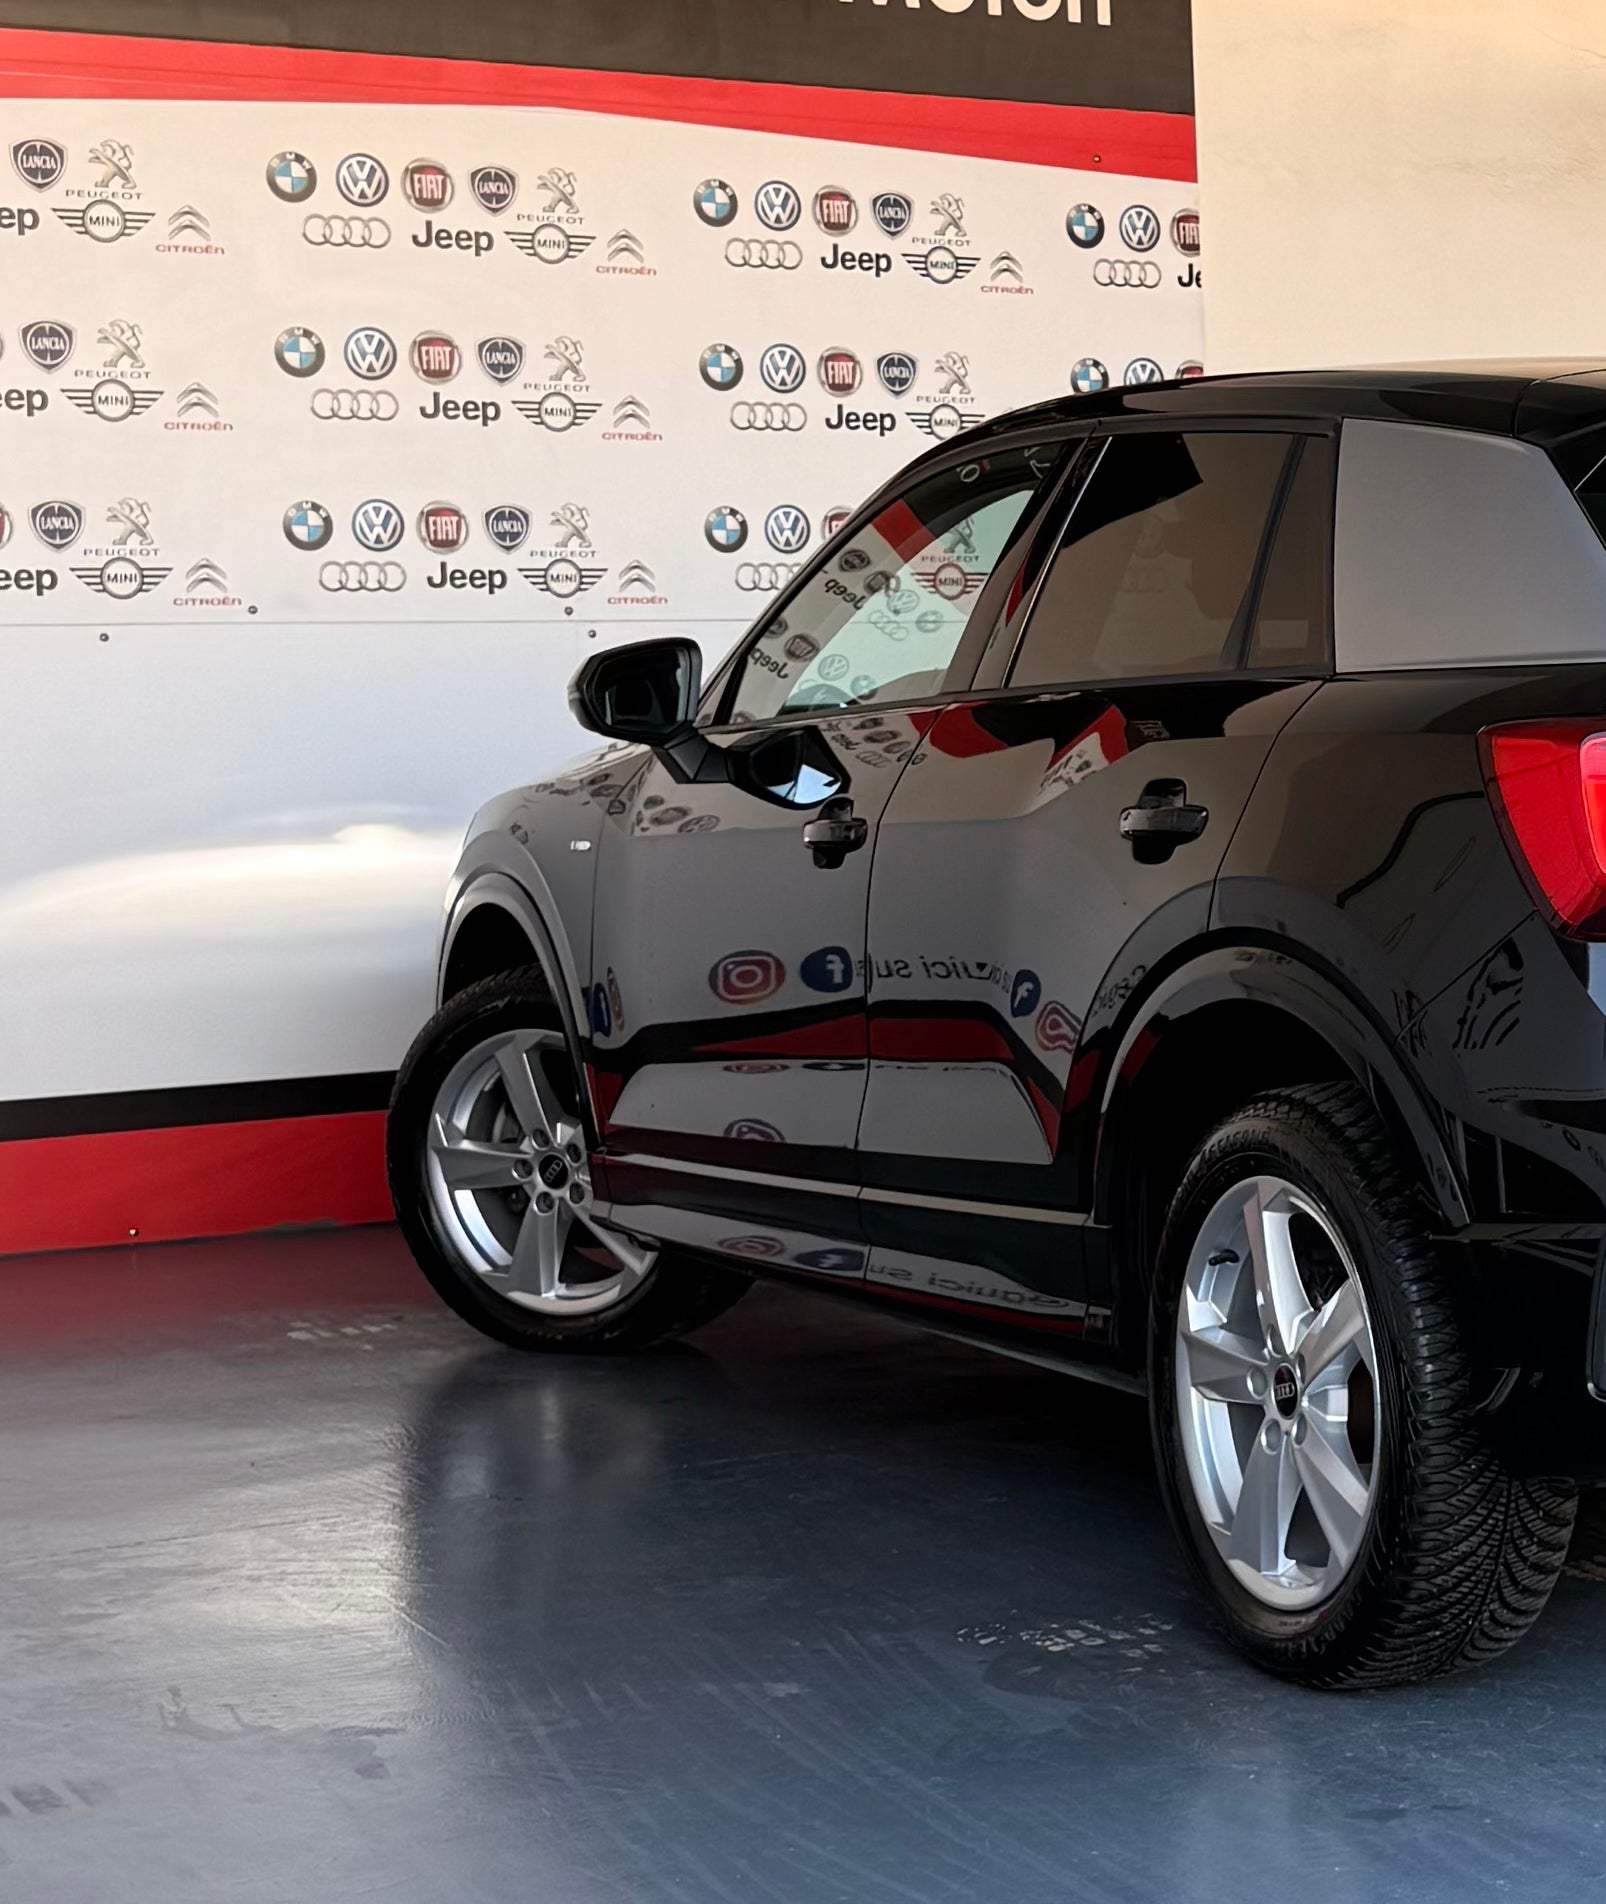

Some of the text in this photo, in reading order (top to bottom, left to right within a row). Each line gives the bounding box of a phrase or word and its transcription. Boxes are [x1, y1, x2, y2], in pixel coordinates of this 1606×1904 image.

[23, 154, 57, 170] LANCIA
[414, 173, 445, 200] FIAT
[65, 189, 143, 200] PEUGEOT
[822, 199, 850, 224] FIAT
[89, 215, 120, 227] MINI
[516, 213, 585, 224] PEUGEOT
[412, 220, 494, 257] Jeep
[1179, 222, 1200, 245] FIA
[537, 238, 565, 250] MINI
[912, 236, 971, 247] PEUGEOT
[821, 243, 893, 278] Jeep
[930, 260, 955, 270] MINI
[31, 336, 65, 351] LANCIA
[420, 346, 452, 371] FIAT
[74, 369, 152, 380] PEUGEOT
[826, 361, 855, 385] FIAT
[523, 382, 592, 393] PEUGEOT
[0, 388, 49, 417] ep
[98, 395, 129, 406] MINI
[916, 395, 976, 404] PEUGEOT
[419, 391, 501, 427] Jeep
[544, 407, 572, 417] MINI
[825, 404, 897, 437] Jeep
[933, 417, 958, 428] MINI
[41, 516, 75, 530] LANCIA
[428, 515, 459, 541] FIAT
[83, 547, 160, 557] PEUGEOT
[530, 549, 598, 558] PEUGEOT
[107, 574, 138, 584] MINI
[427, 561, 508, 595] Jeep
[550, 573, 578, 584] MINI
[938, 576, 963, 586] MINI
